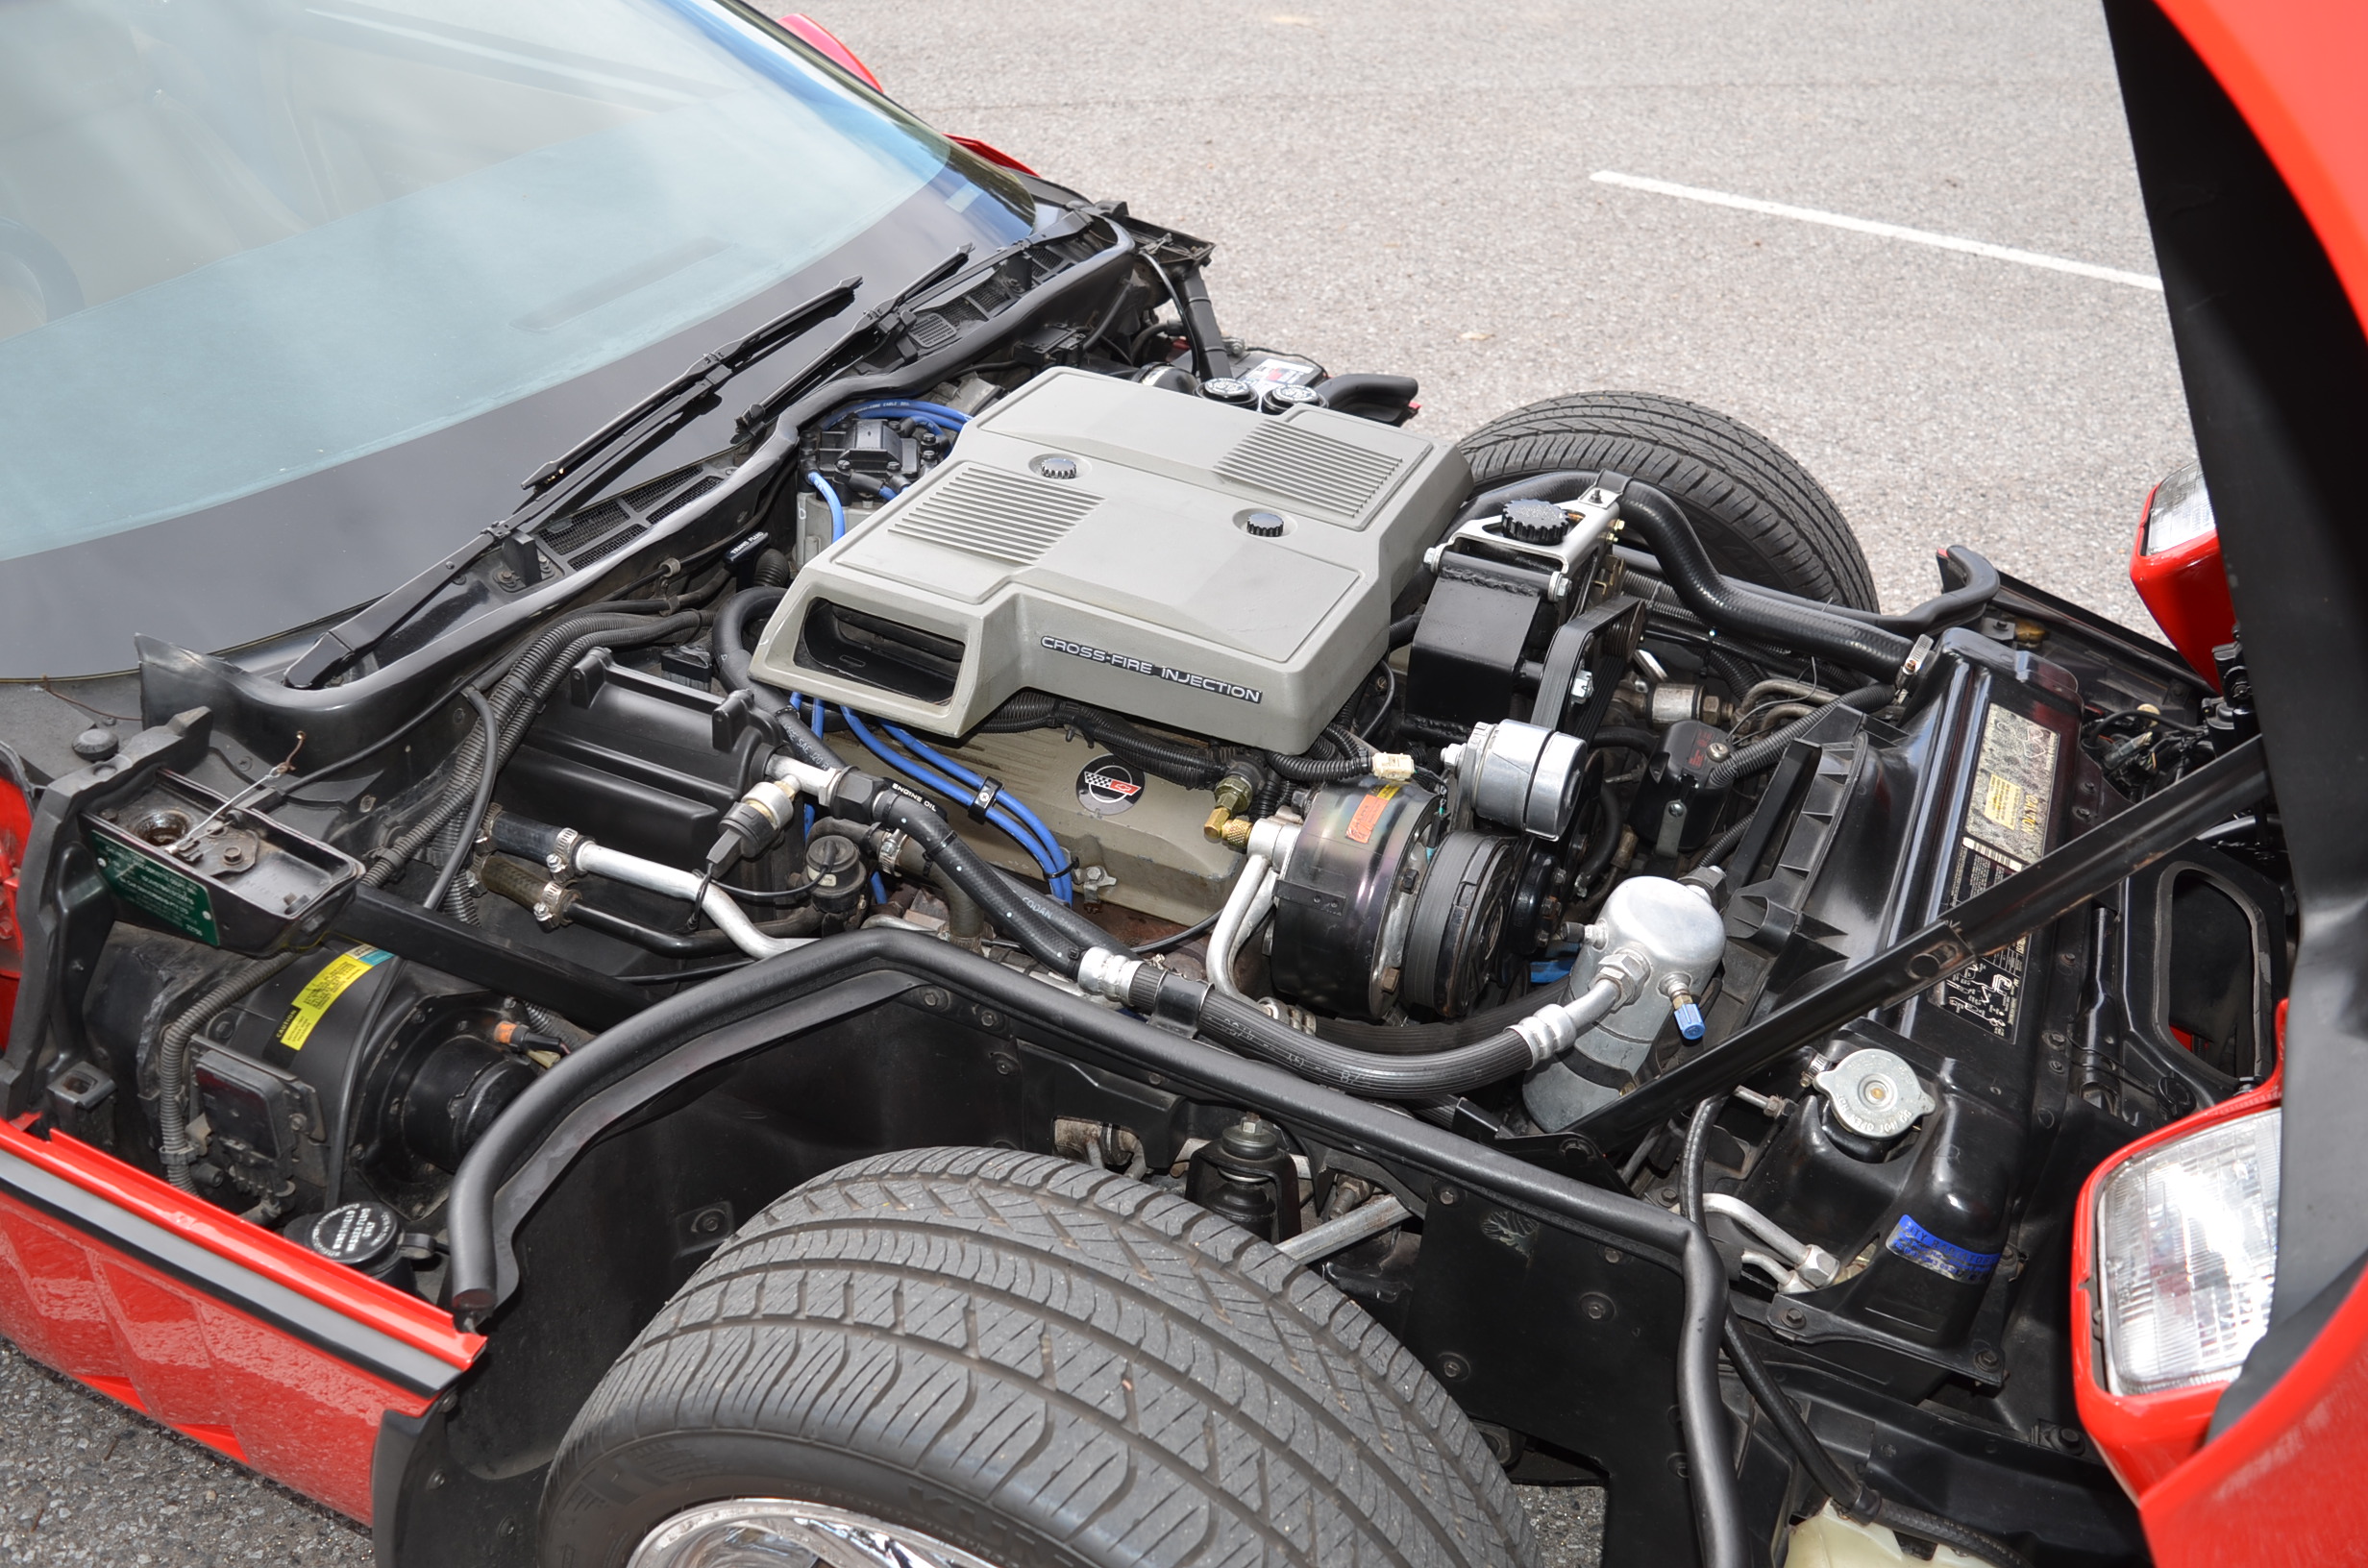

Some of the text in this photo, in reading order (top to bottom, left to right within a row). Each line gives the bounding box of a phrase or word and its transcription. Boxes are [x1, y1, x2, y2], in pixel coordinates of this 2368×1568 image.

[729, 531, 764, 553] TRANS FLUID
[1041, 636, 1262, 703] CROSS-FIRE INJECTION
[796, 738, 812, 754] SAE
[809, 750, 824, 765] J20
[892, 782, 937, 812] ENGINE OIL
[2021, 795, 2037, 835] CAUTION
[1022, 895, 1053, 919] CODAN
[276, 1010, 296, 1037] CAUTION
[1850, 1115, 1874, 1132] OPEN
[333, 1211, 356, 1248] WINDSHIELD
[345, 1226, 361, 1251] WASHER
[362, 1221, 376, 1237] ONLY
